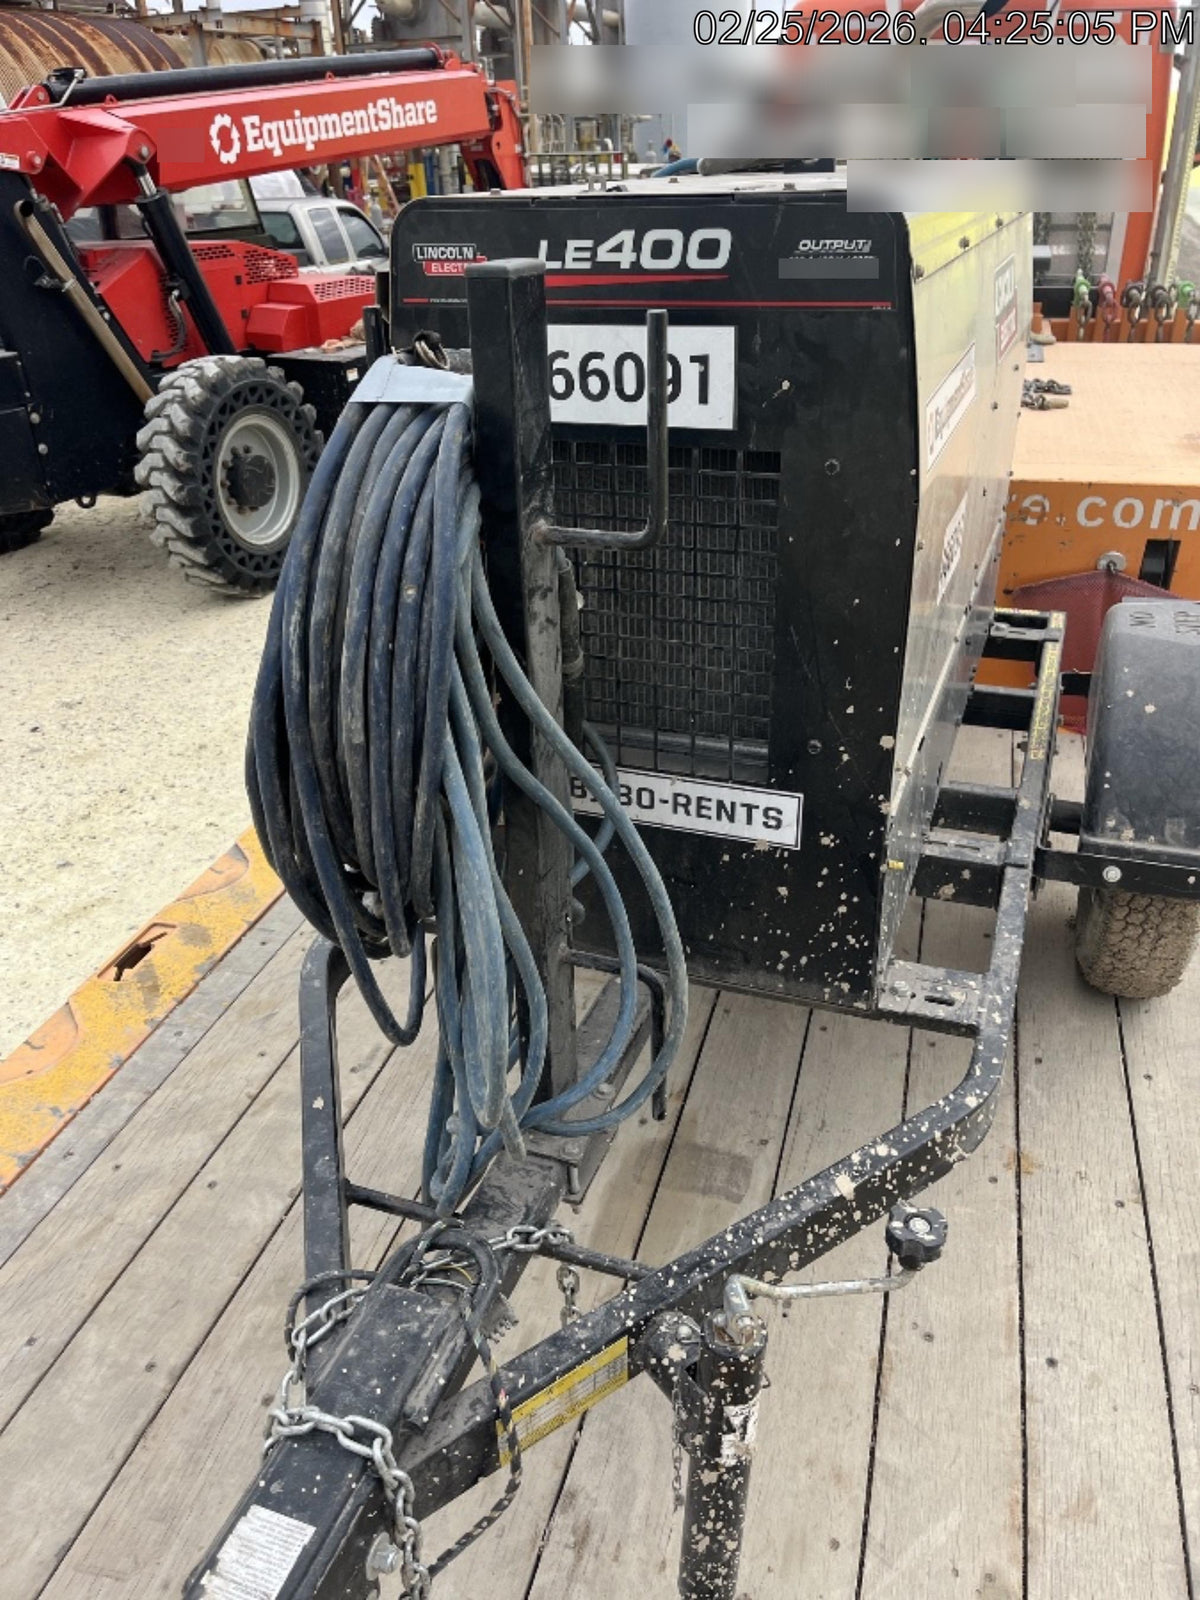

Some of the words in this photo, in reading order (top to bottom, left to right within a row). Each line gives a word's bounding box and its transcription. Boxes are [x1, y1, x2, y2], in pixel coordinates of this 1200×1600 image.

[241, 97, 438, 157] EquipmentShare
[416, 246, 474, 259] LINCOLN
[537, 228, 732, 270] LE400
[798, 239, 867, 250] OUTPUT
[431, 262, 467, 273] ELECT
[1009, 493, 1200, 531] e.com
